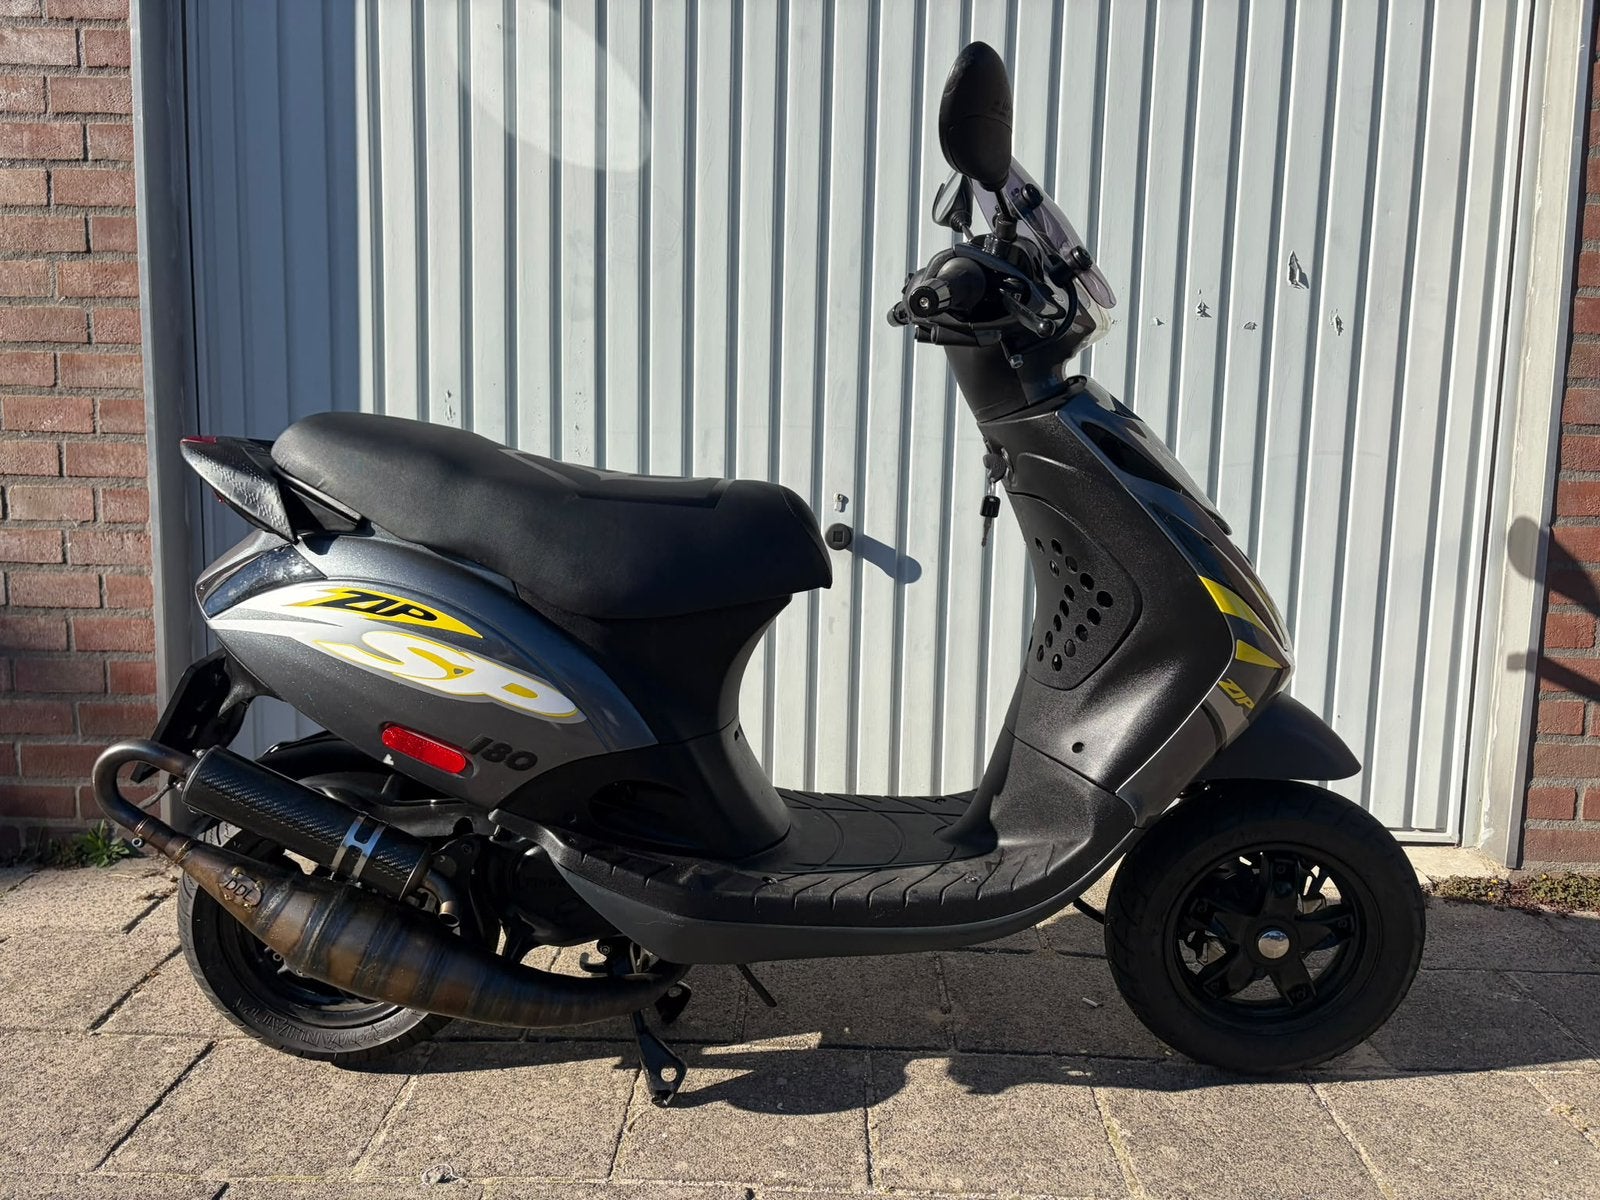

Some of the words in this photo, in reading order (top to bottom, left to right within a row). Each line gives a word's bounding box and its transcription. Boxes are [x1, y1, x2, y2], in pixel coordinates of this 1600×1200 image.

[320, 590, 438, 622] ZIP
[1218, 678, 1255, 710] ZIP
[471, 736, 538, 771] 180
